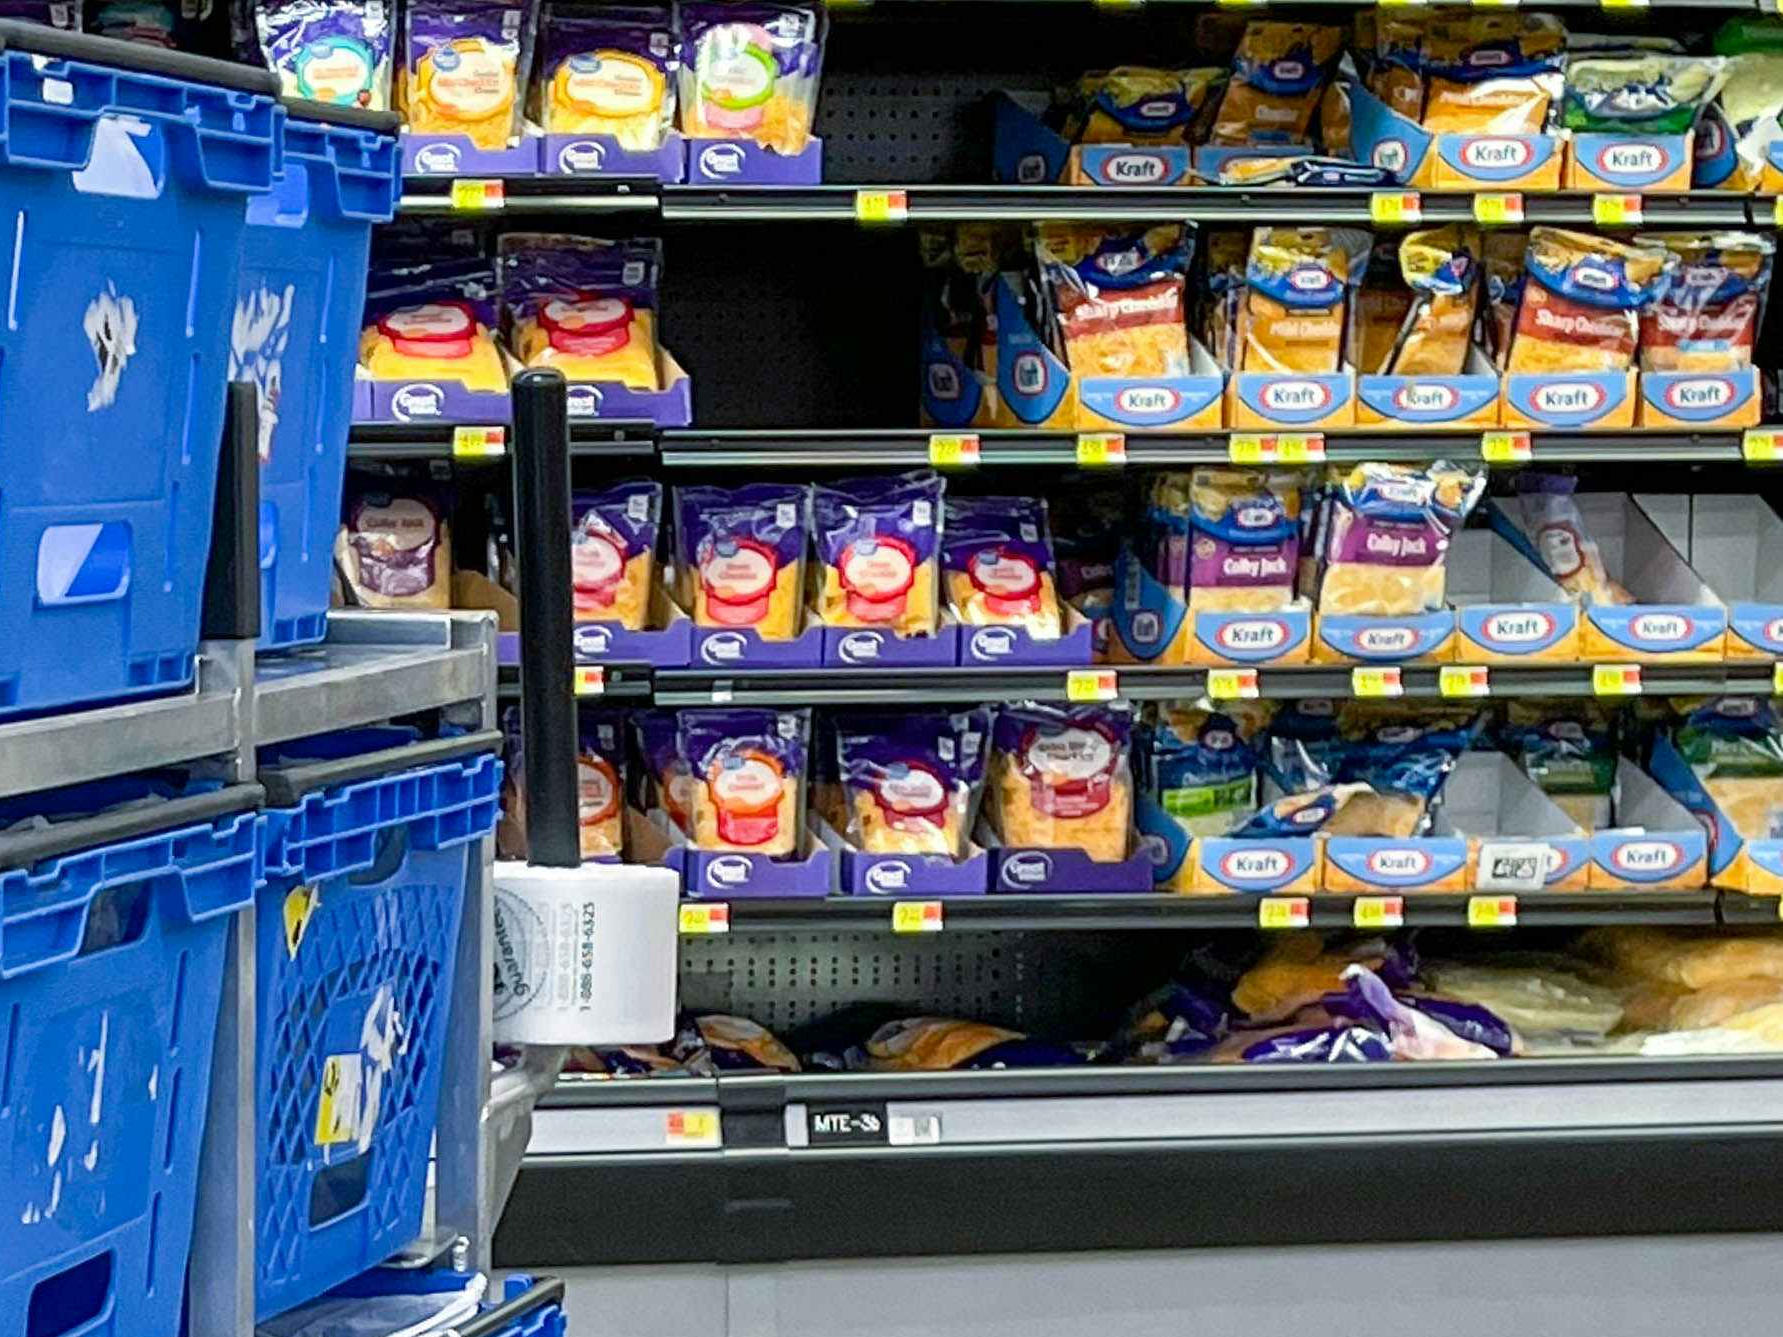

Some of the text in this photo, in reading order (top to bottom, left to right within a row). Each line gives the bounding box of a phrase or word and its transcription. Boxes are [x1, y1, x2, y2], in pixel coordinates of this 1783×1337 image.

[1474, 142, 1518, 163] Kraft
[1611, 146, 1653, 168] Kraft
[1115, 157, 1156, 177] Kraft
[1128, 391, 1167, 410] Kraft
[1273, 388, 1316, 405] Kraft
[1545, 391, 1588, 406] Kraft
[1679, 387, 1720, 404] Kraft
[1367, 533, 1401, 556] Colby
[1224, 556, 1288, 578] Colby Jack
[1496, 618, 1539, 636] Kraft
[1641, 621, 1678, 636] Kraft
[1231, 629, 1274, 644] Kraft
[1367, 630, 1406, 647] Kraft
[1235, 855, 1279, 873] Kraft
[1379, 854, 1418, 872] Kraft
[1626, 847, 1668, 866] Kraft
